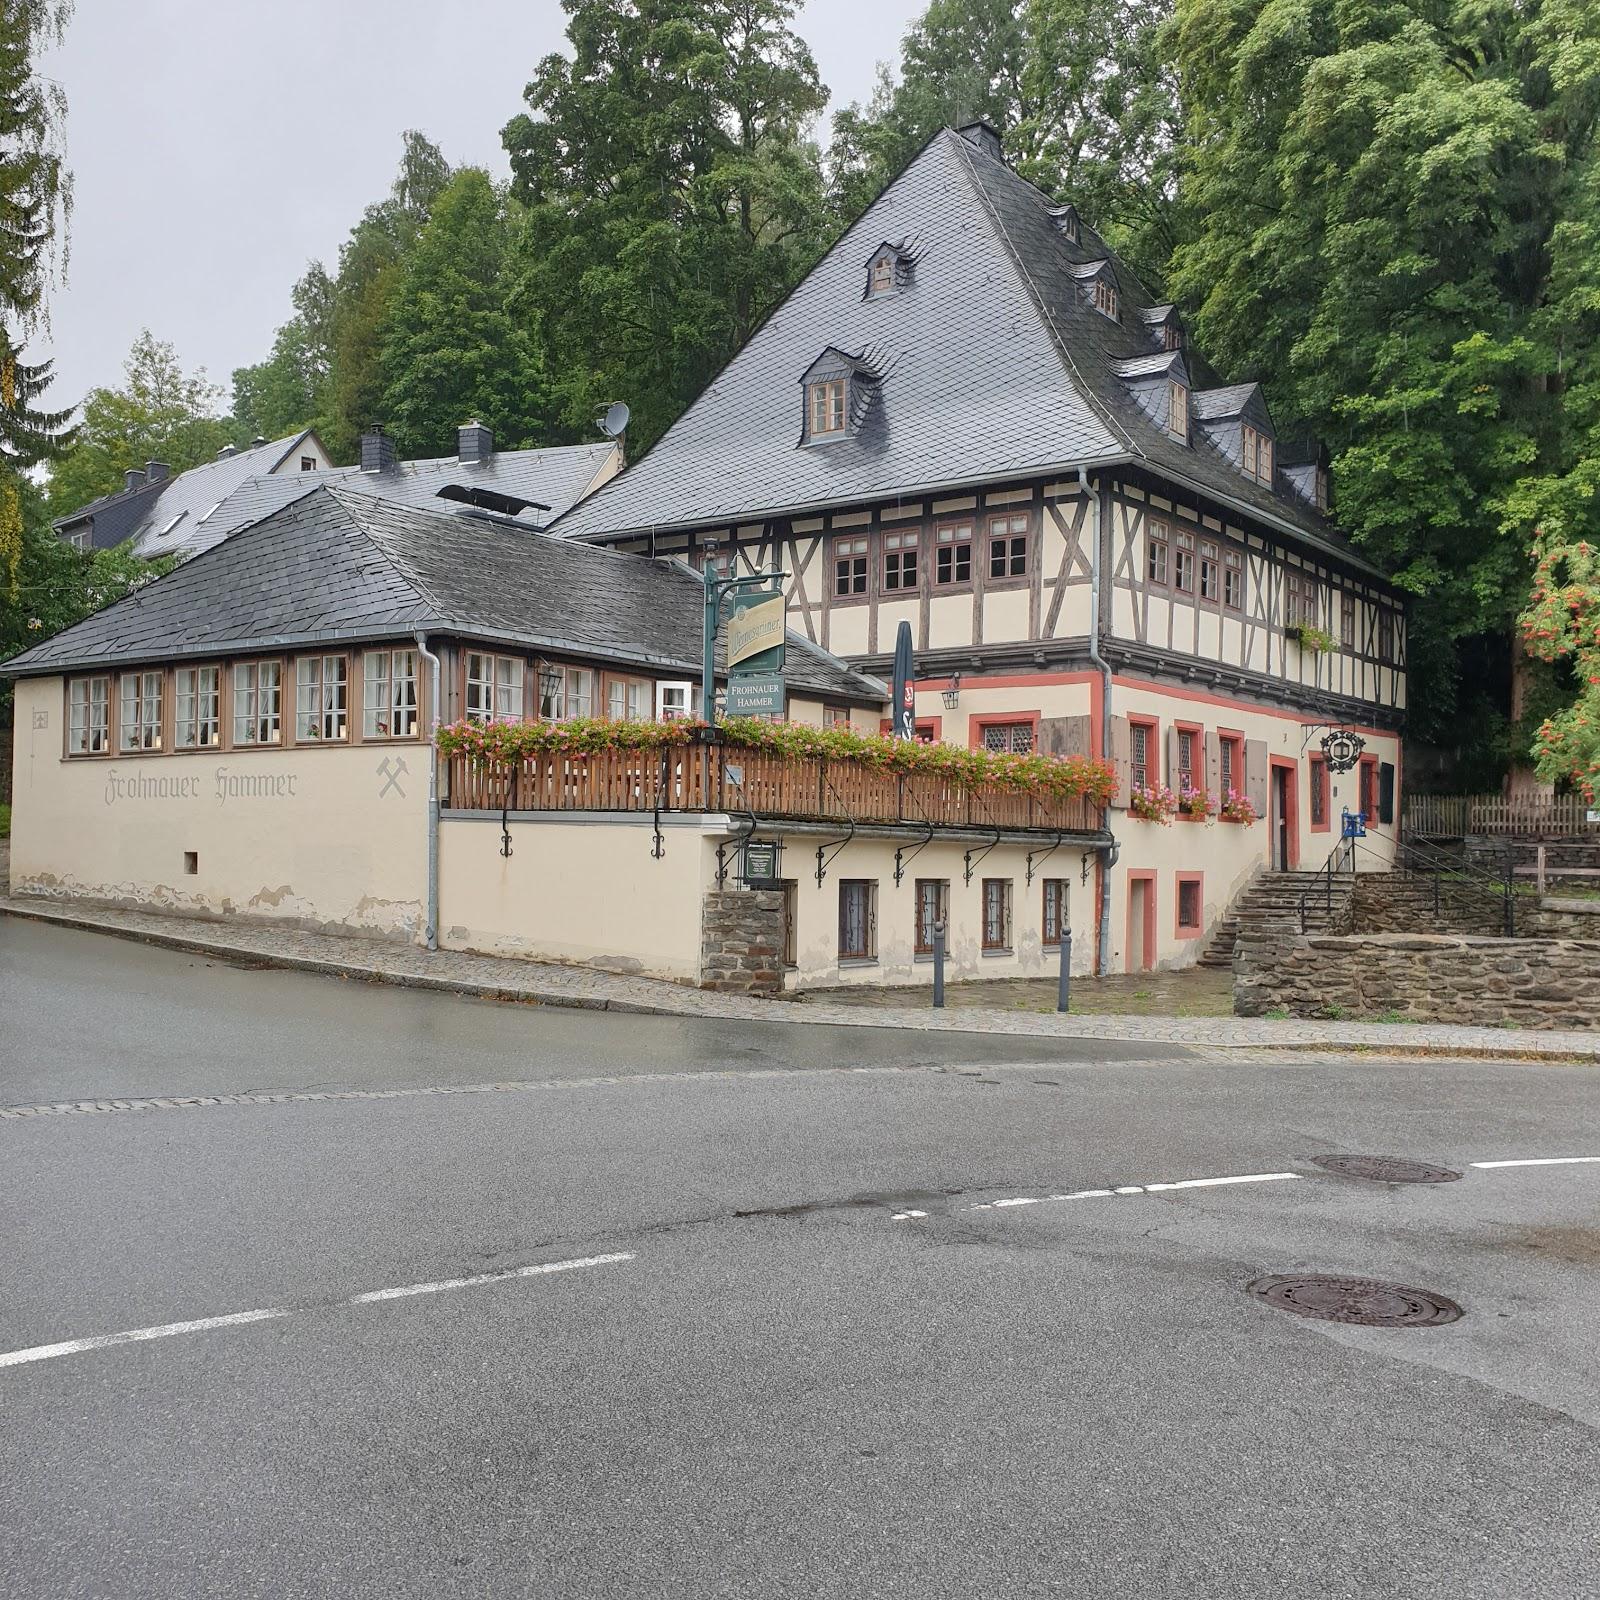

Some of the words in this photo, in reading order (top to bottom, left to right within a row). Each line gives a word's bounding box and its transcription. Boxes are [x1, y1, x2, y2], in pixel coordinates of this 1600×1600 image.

[731, 684, 779, 695] FROHNAUER
[737, 697, 773, 707] HAMMER
[105, 769, 199, 806] Frohnauer
[215, 766, 297, 808] Hammer
